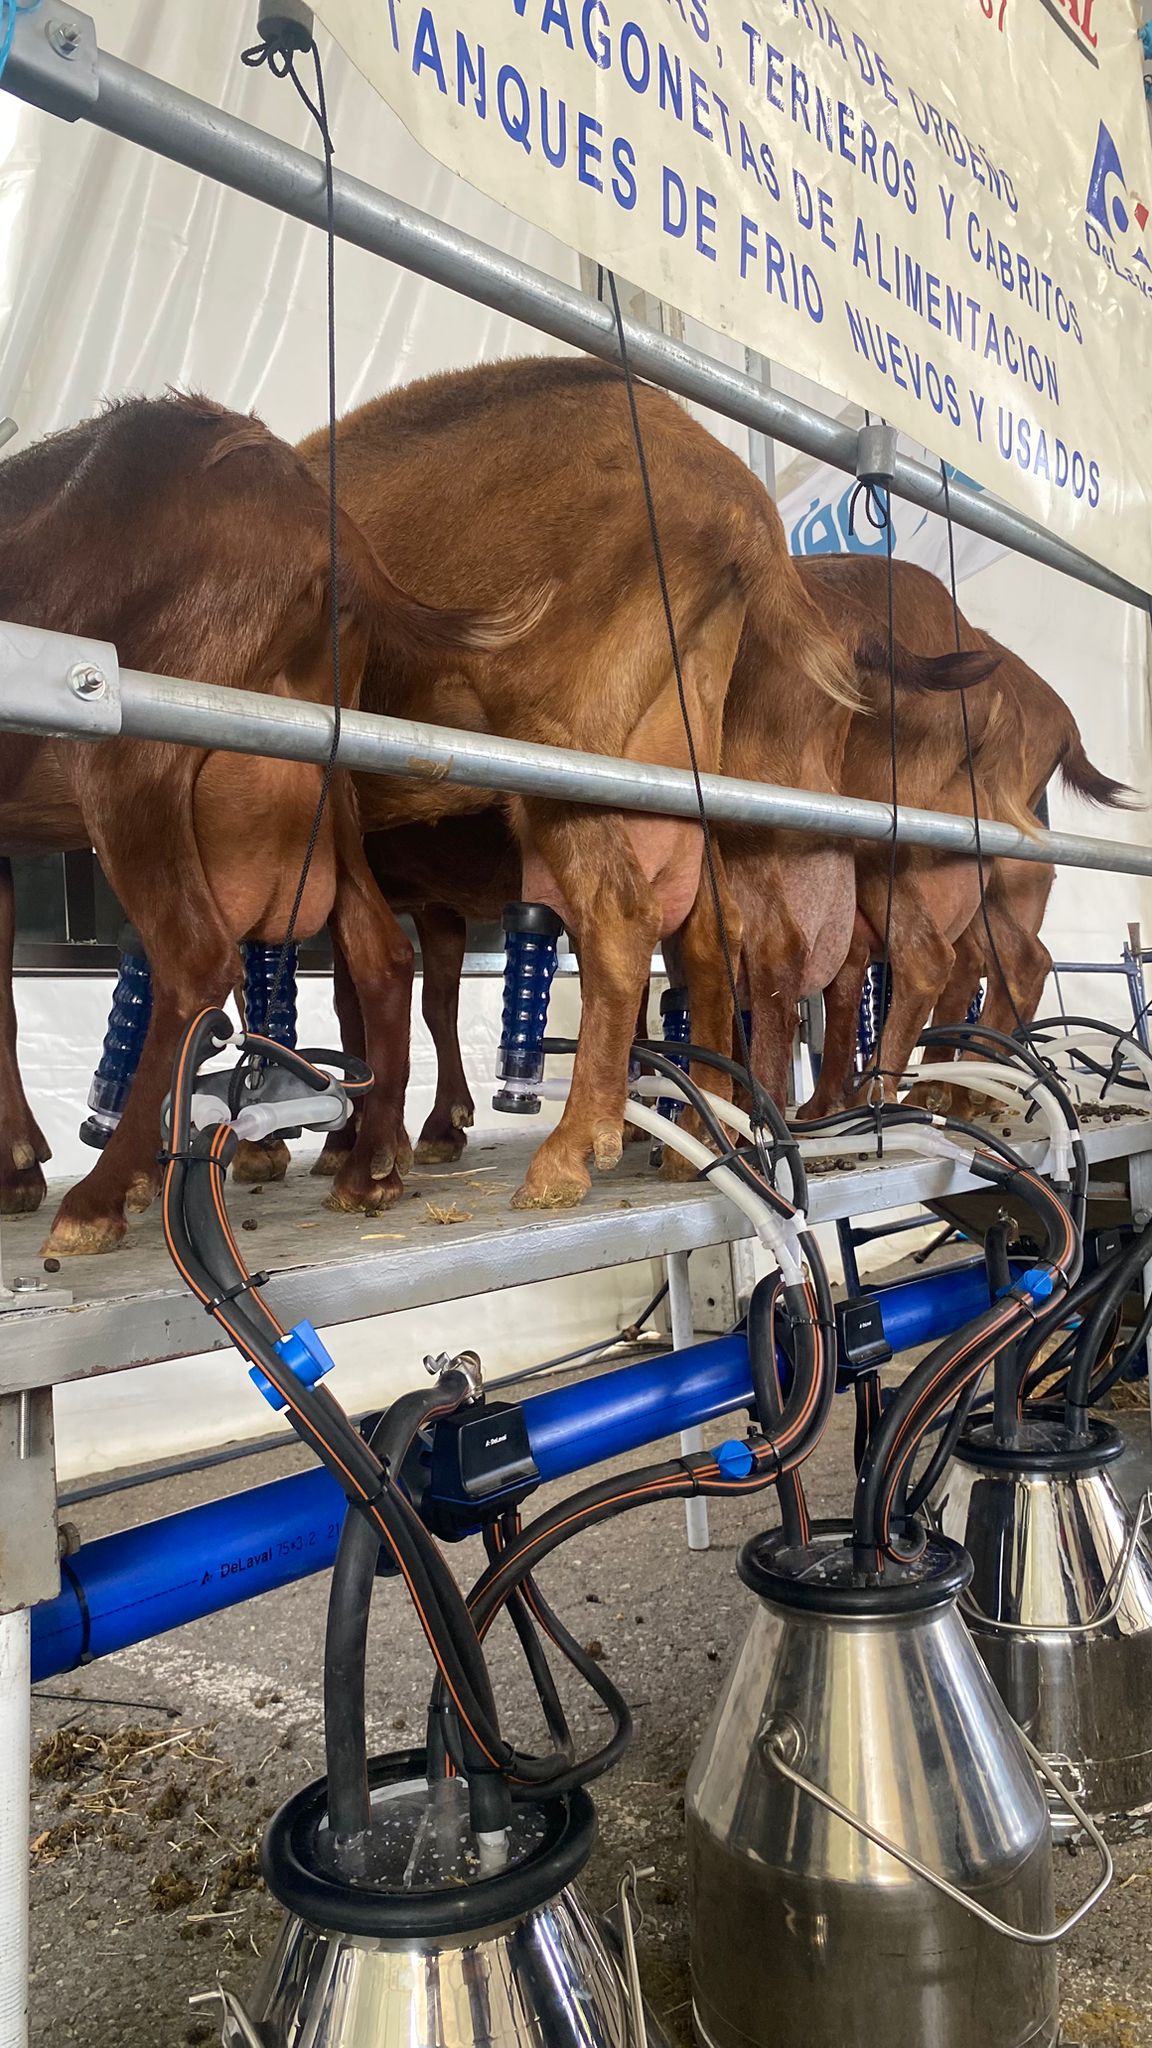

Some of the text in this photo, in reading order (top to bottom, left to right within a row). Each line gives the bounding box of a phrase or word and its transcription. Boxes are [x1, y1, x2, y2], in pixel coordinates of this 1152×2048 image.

[513, 0, 1060, 406] AGONETAS DE ALIMENTACION
[742, 21, 917, 215] TERNEROS
[938, 184, 955, 241] Y
[967, 211, 1083, 345] CABRITOS
[852, 32, 898, 107] DE
[908, 87, 1018, 213] ORDEÑO
[662, 164, 717, 262] DE
[740, 214, 824, 324] FRIO
[845, 300, 961, 426] NUEVOS
[969, 389, 985, 442] Y
[998, 406, 1100, 508] USADOS
[220, 1548, 272, 1578] DeLaval
